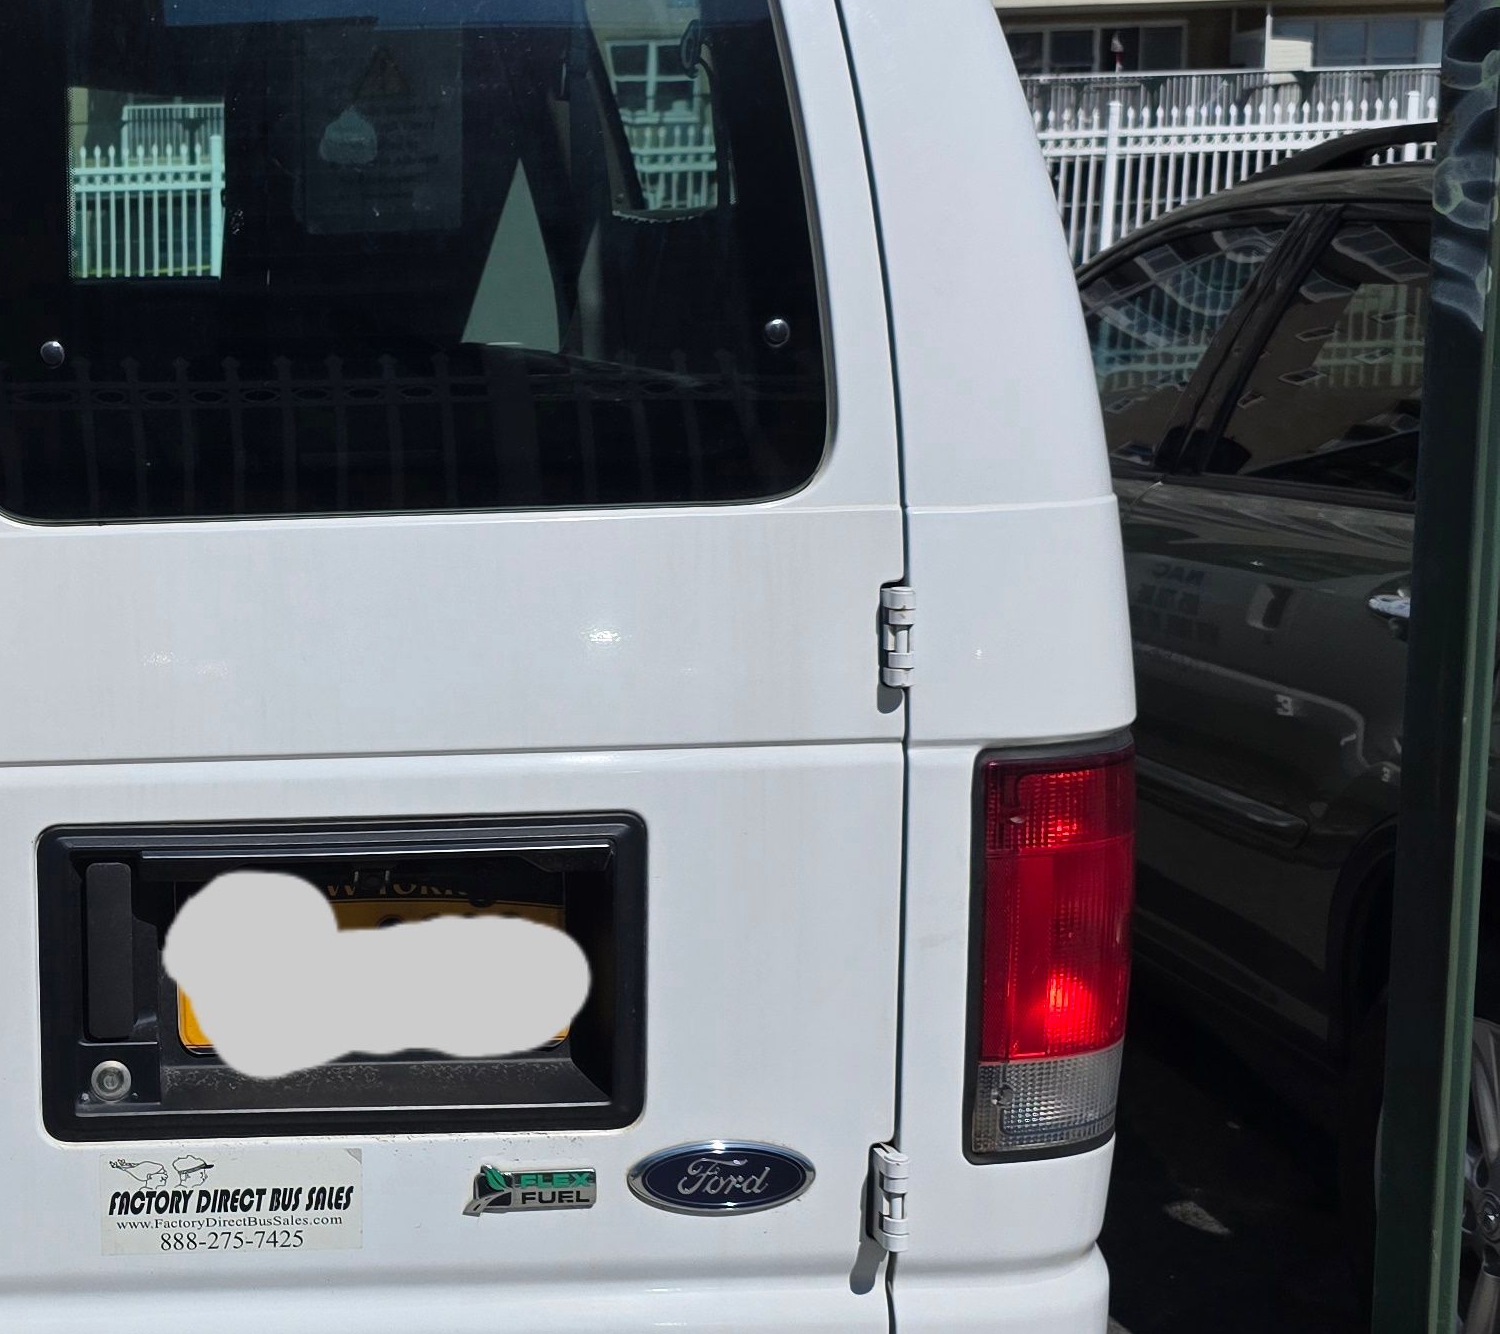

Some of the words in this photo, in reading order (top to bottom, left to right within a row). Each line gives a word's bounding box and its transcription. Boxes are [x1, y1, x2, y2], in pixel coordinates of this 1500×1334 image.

[520, 1172, 592, 1188] FLEX
[676, 1157, 771, 1196] Ford
[108, 1188, 194, 1216] FACTORY
[196, 1187, 267, 1214] DIRECT
[269, 1186, 303, 1212] BUS
[305, 1185, 354, 1211] SALES
[521, 1189, 590, 1205] FUEL
[116, 1215, 343, 1230] www.FactoryDirectBusSales.com
[160, 1230, 304, 1251] 888-275-7425
